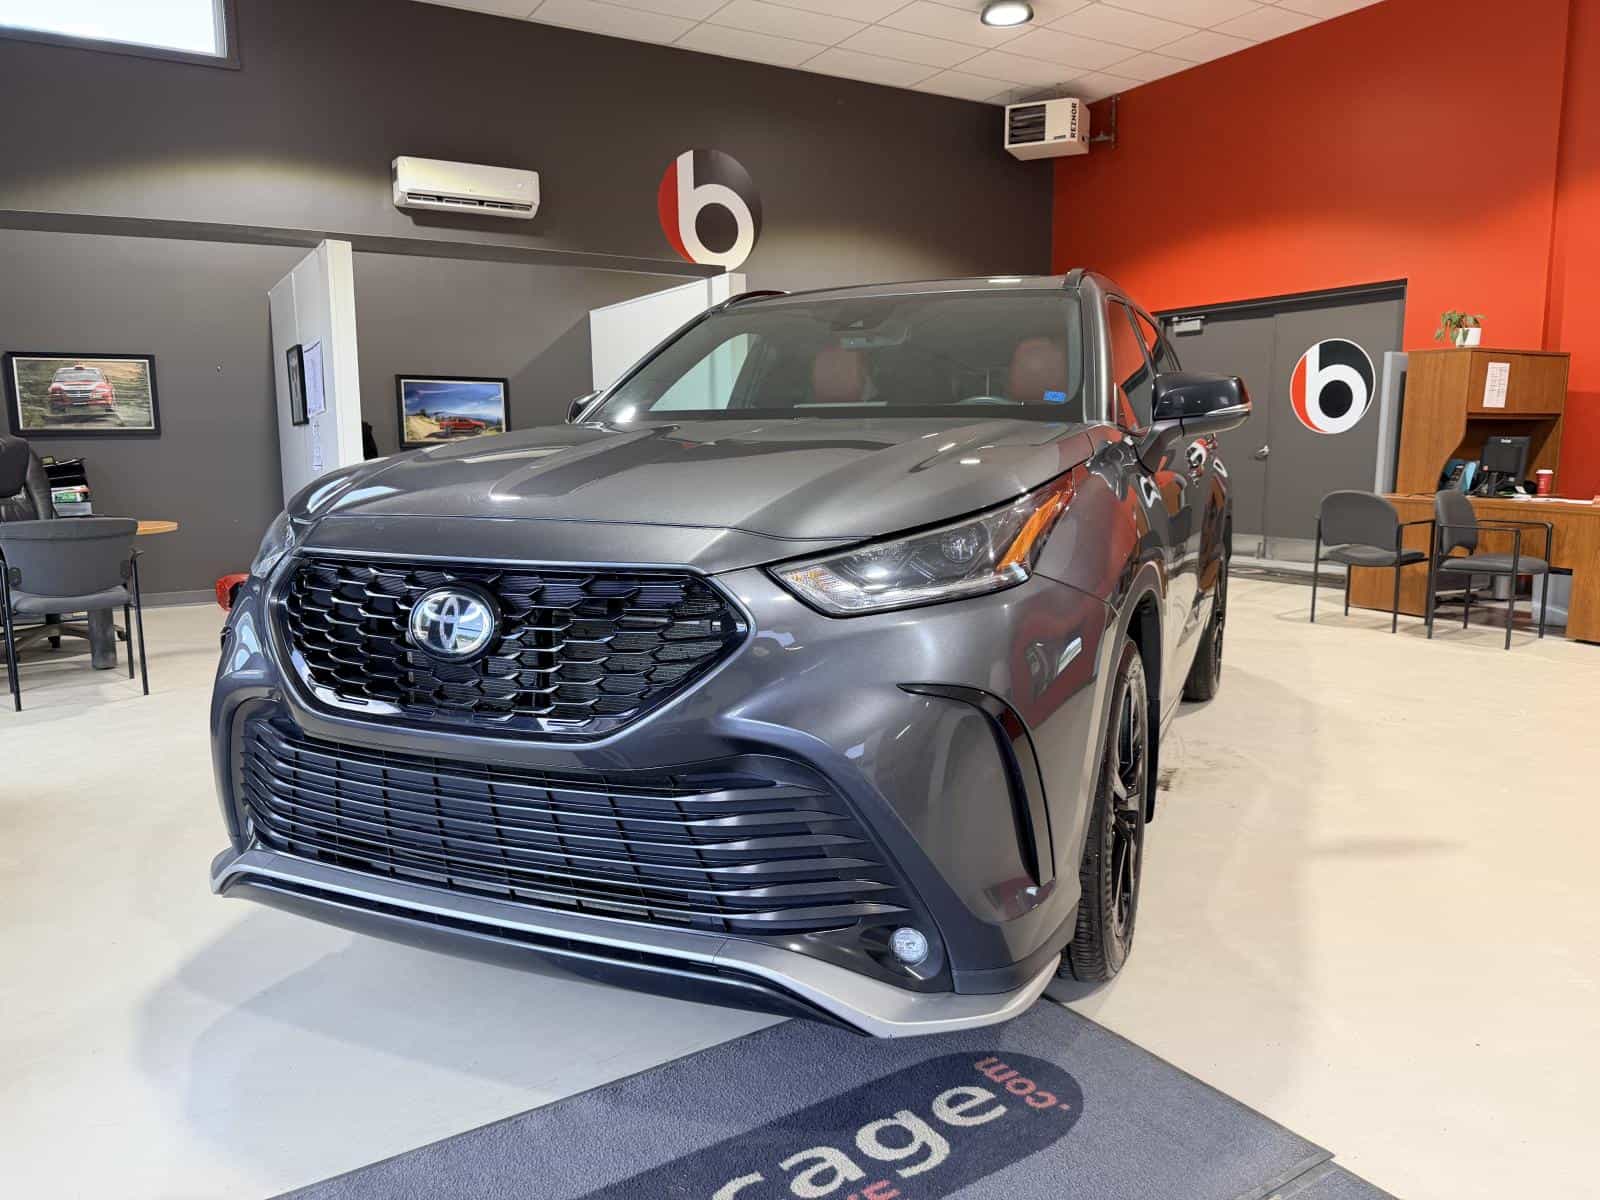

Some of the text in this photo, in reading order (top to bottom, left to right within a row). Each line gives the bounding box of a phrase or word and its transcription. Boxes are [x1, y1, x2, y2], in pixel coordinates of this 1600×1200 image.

[1070, 102, 1078, 138] REZNOR
[676, 148, 755, 272] b
[1305, 342, 1368, 434] b
[975, 1056, 1071, 1110] .com
